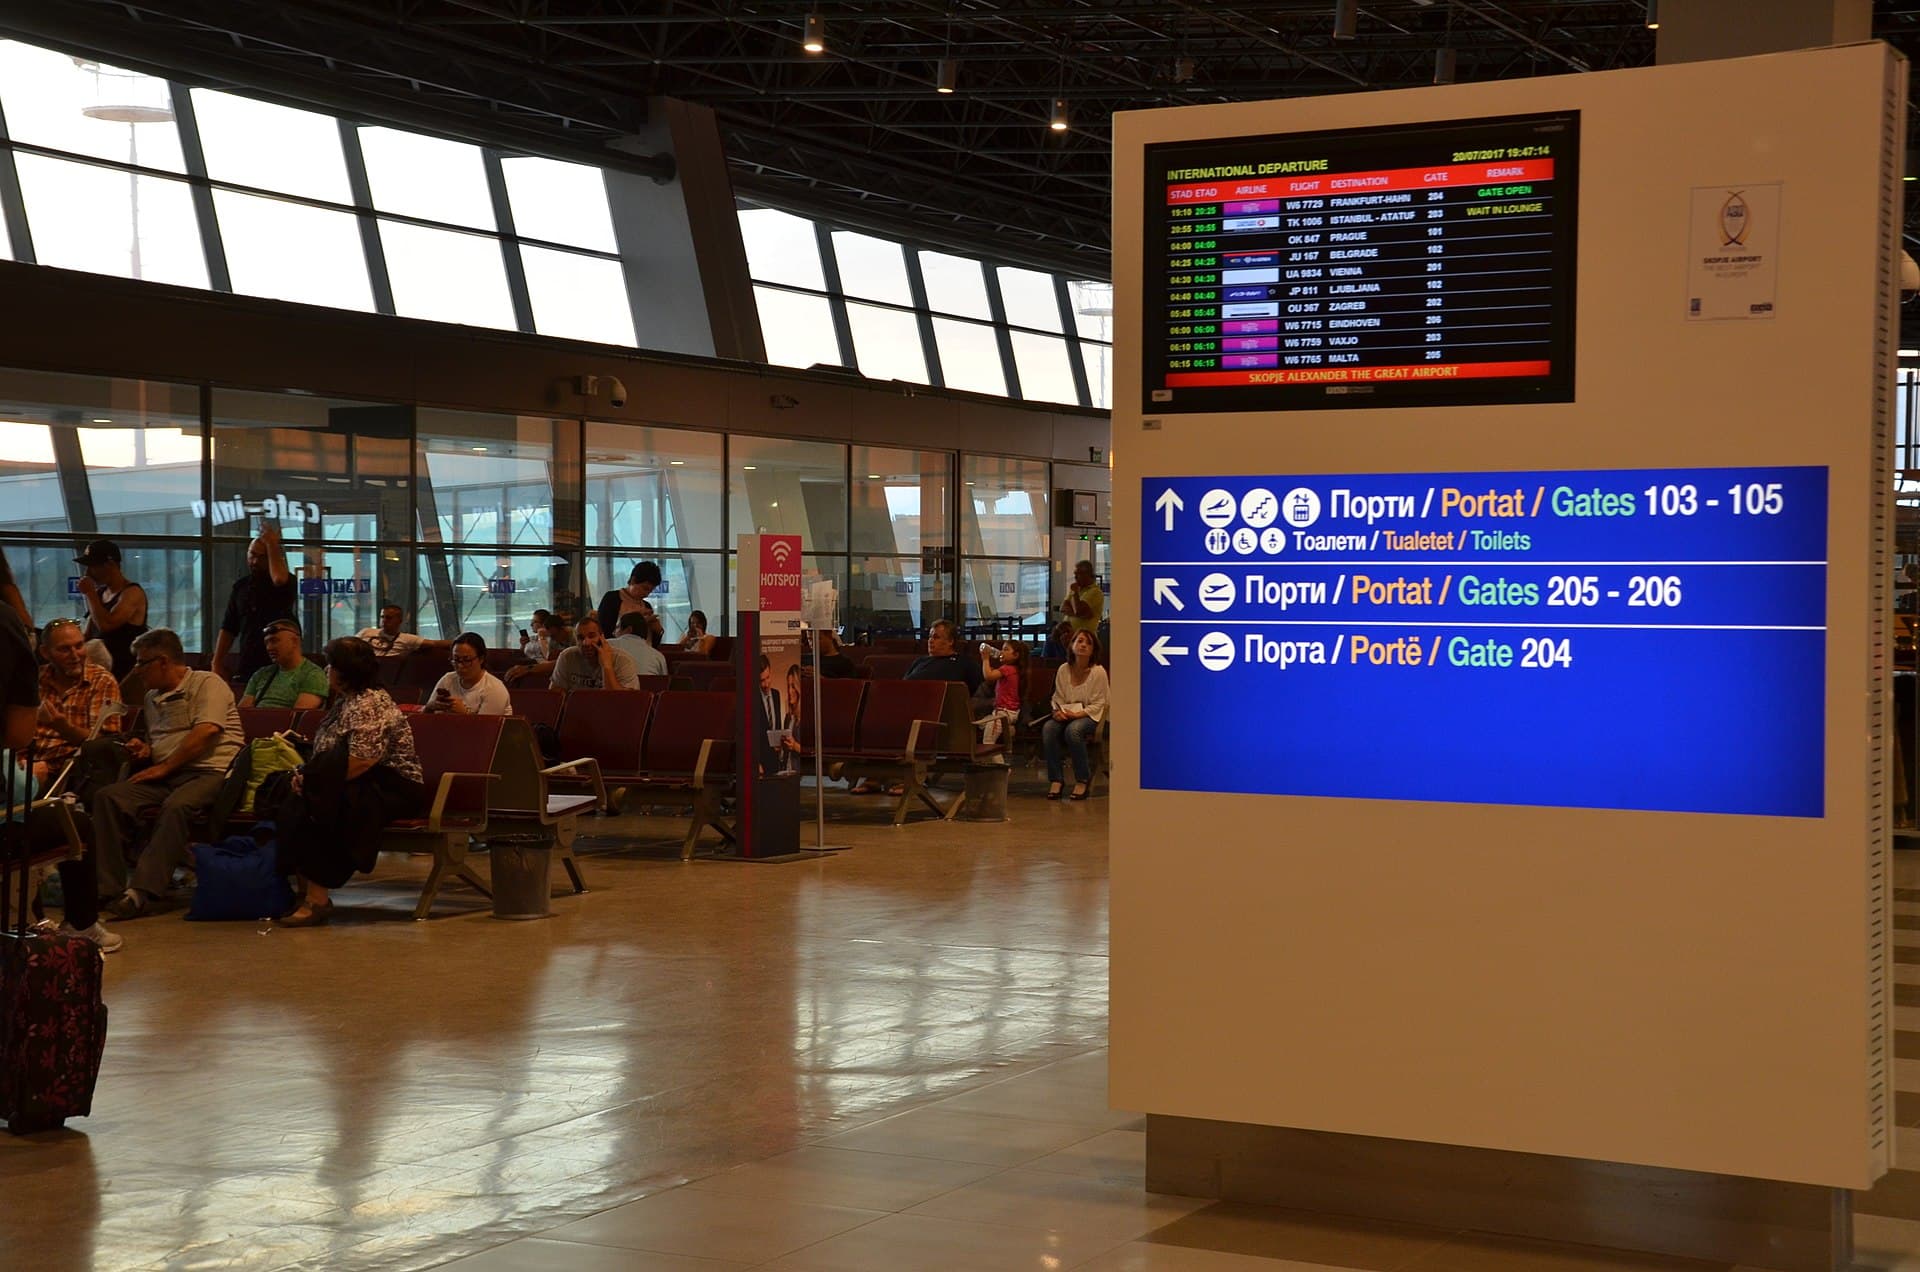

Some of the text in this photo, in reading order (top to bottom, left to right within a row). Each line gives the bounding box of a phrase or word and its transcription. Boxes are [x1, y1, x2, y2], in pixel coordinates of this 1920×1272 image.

[1452, 145, 1550, 162] 20/07/2017 19:47:14
[1167, 159, 1329, 181] INTERNATIONAL DEPARTURE
[1170, 167, 1525, 199] STAD ETAD AIRLINE FLIGHT DESTINATION GATE REMARK
[1286, 202, 1301, 210] W6
[1302, 200, 1323, 208] 7729
[1331, 194, 1411, 207] FRANKFURT-HAHN
[1478, 188, 1503, 197] GATE
[1505, 185, 1532, 195] OPEN
[1287, 219, 1300, 227] TK
[1330, 214, 1373, 224] ISTANBUL
[1467, 207, 1490, 216] WAIT
[1492, 206, 1502, 214] IN
[1504, 203, 1542, 213] LOUNGE
[1288, 236, 1302, 244] OK
[1304, 235, 1320, 243] 847
[1330, 232, 1367, 241] PRAGUE
[1289, 253, 1301, 261] JU
[1304, 252, 1319, 260] 167
[1330, 249, 1378, 259] BELGRADE
[1286, 270, 1299, 279] UA
[1301, 269, 1321, 277] 9834
[1330, 267, 1362, 277] VIENNA
[1289, 288, 1301, 296] JP
[1302, 286, 1318, 295] 811
[1329, 283, 1380, 294] LJUBLJANA
[1288, 305, 1302, 313] OU
[1303, 304, 1319, 312] 367
[1329, 302, 1366, 311] ZAGREB
[1285, 321, 1298, 330] W6
[1301, 321, 1322, 329] 7715
[1329, 319, 1380, 329] EINDHOVEN
[1285, 339, 1298, 347] W6
[1301, 338, 1322, 346] 7759
[1329, 336, 1358, 346] VAXJO
[1285, 356, 1298, 365] W6
[1301, 355, 1321, 364] 7765
[1328, 354, 1359, 363] MALTA
[1249, 366, 1459, 383] SKOPJE ALEXANDER THE GREAT AIRPORT
[1331, 489, 1414, 525] Порти
[1441, 486, 1524, 517] Portat
[1552, 487, 1636, 516] Gates
[1644, 484, 1698, 515] 103
[1728, 483, 1783, 515] 105
[1293, 531, 1366, 551] Тоалети
[1383, 530, 1454, 550] Tualetet
[1471, 530, 1531, 551] Toilets
[760, 573, 800, 587] HOTSPOT
[1245, 575, 1326, 611] Порти
[1352, 575, 1432, 605] Portat
[1458, 575, 1540, 606] Gates
[1547, 576, 1599, 606] 205
[1628, 576, 1681, 607] 206
[1245, 634, 1326, 670] Порта
[1351, 635, 1422, 666] Portë
[1448, 636, 1513, 668] Gate
[1520, 638, 1572, 668] 204
